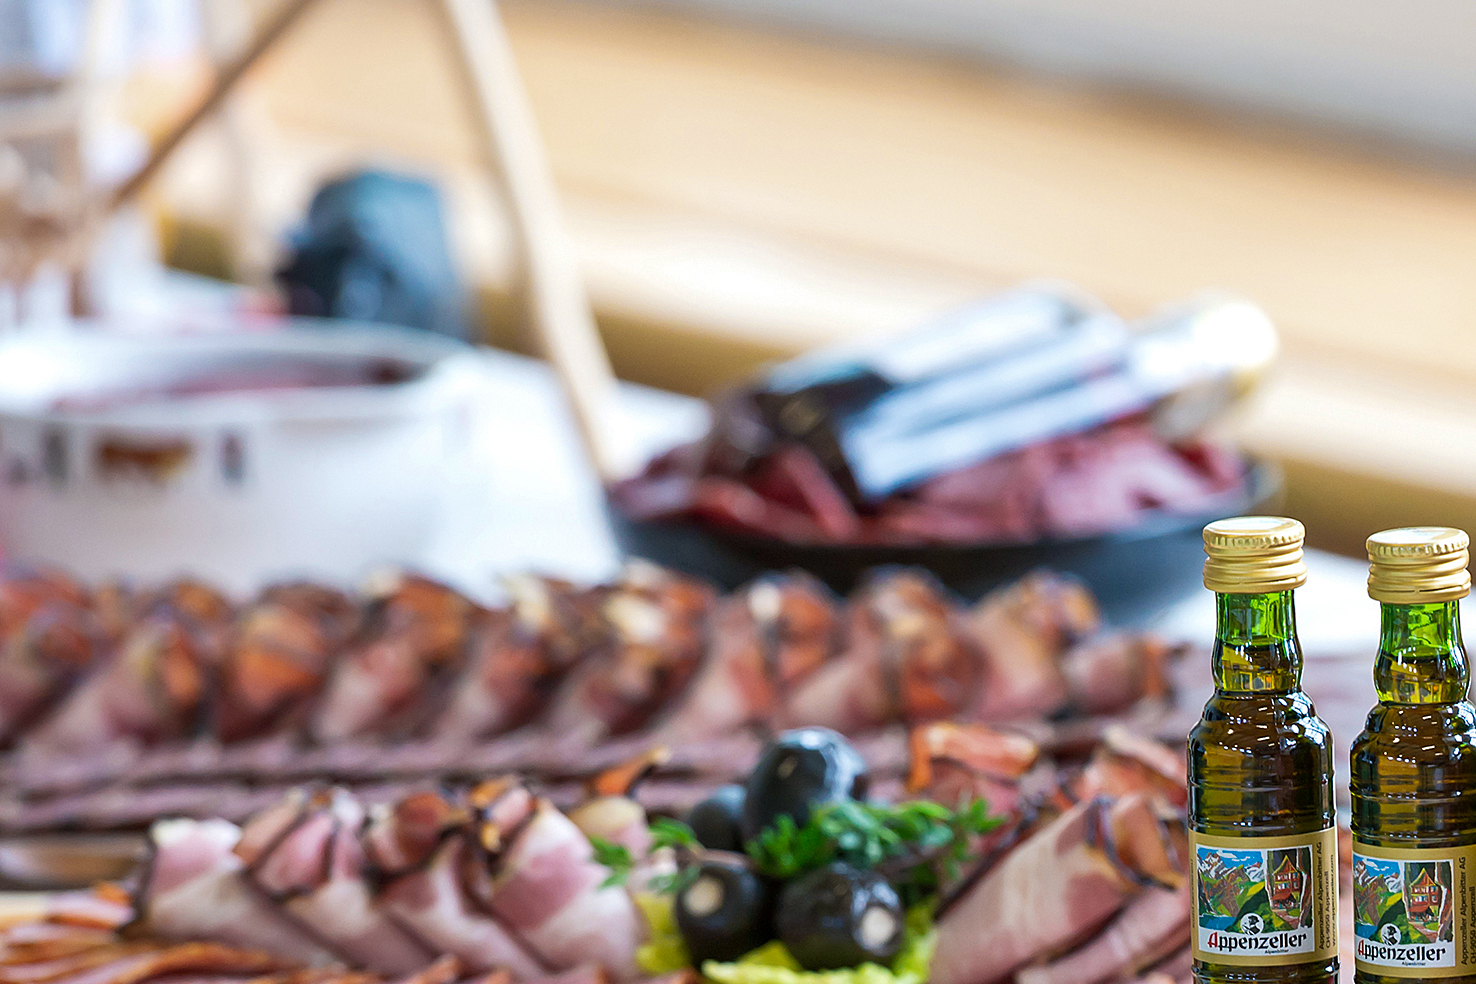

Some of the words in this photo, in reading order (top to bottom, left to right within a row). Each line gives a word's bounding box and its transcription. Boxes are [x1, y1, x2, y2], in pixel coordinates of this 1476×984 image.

[1316, 841, 1322, 854] AG
[1458, 856, 1466, 870] AG
[1316, 857, 1324, 900] Alpenbitter
[1459, 871, 1467, 916] Alpenbitter
[1207, 931, 1307, 952] Appenzeller
[1358, 939, 1446, 961] Appenzeller
[1460, 918, 1468, 966] Appenzeller
